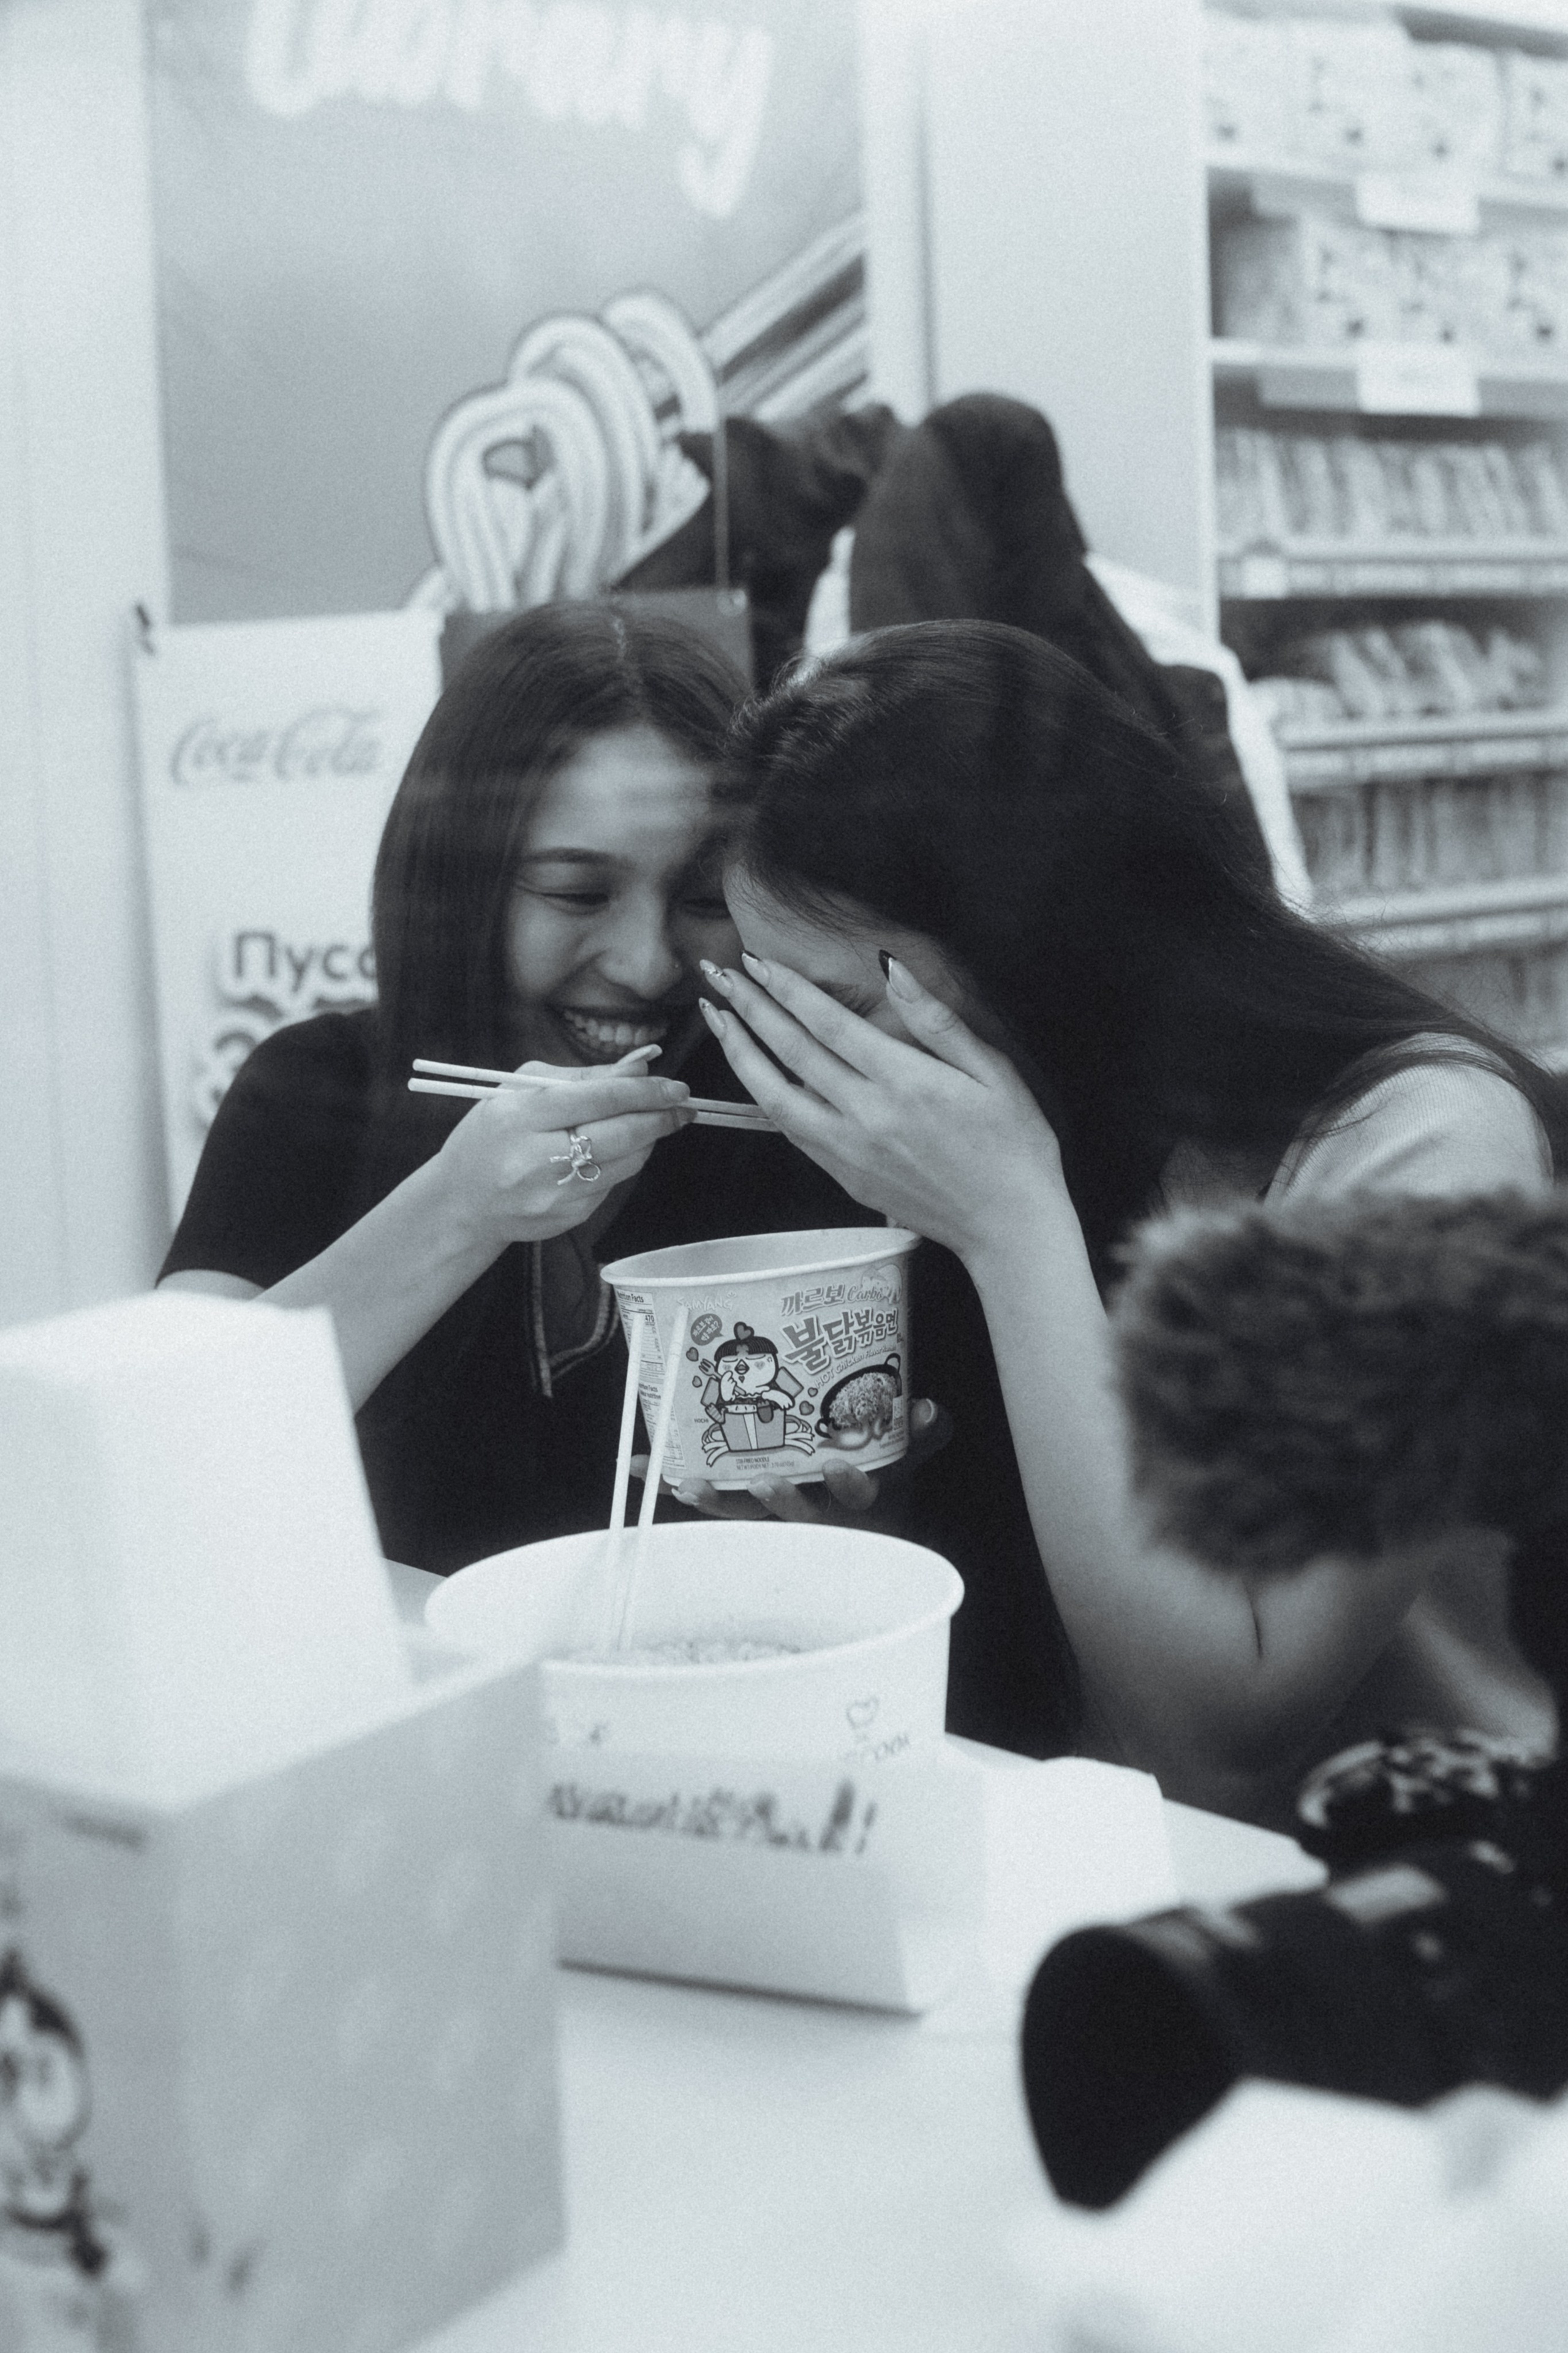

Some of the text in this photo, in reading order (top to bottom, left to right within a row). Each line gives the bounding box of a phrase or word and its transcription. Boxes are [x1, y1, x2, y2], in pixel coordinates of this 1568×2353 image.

[781, 1284, 845, 1315] 까르보
[782, 1307, 898, 1374] 불닭볶음면
[815, 1367, 834, 1389] HOT
[835, 1353, 865, 1373] Chicken
